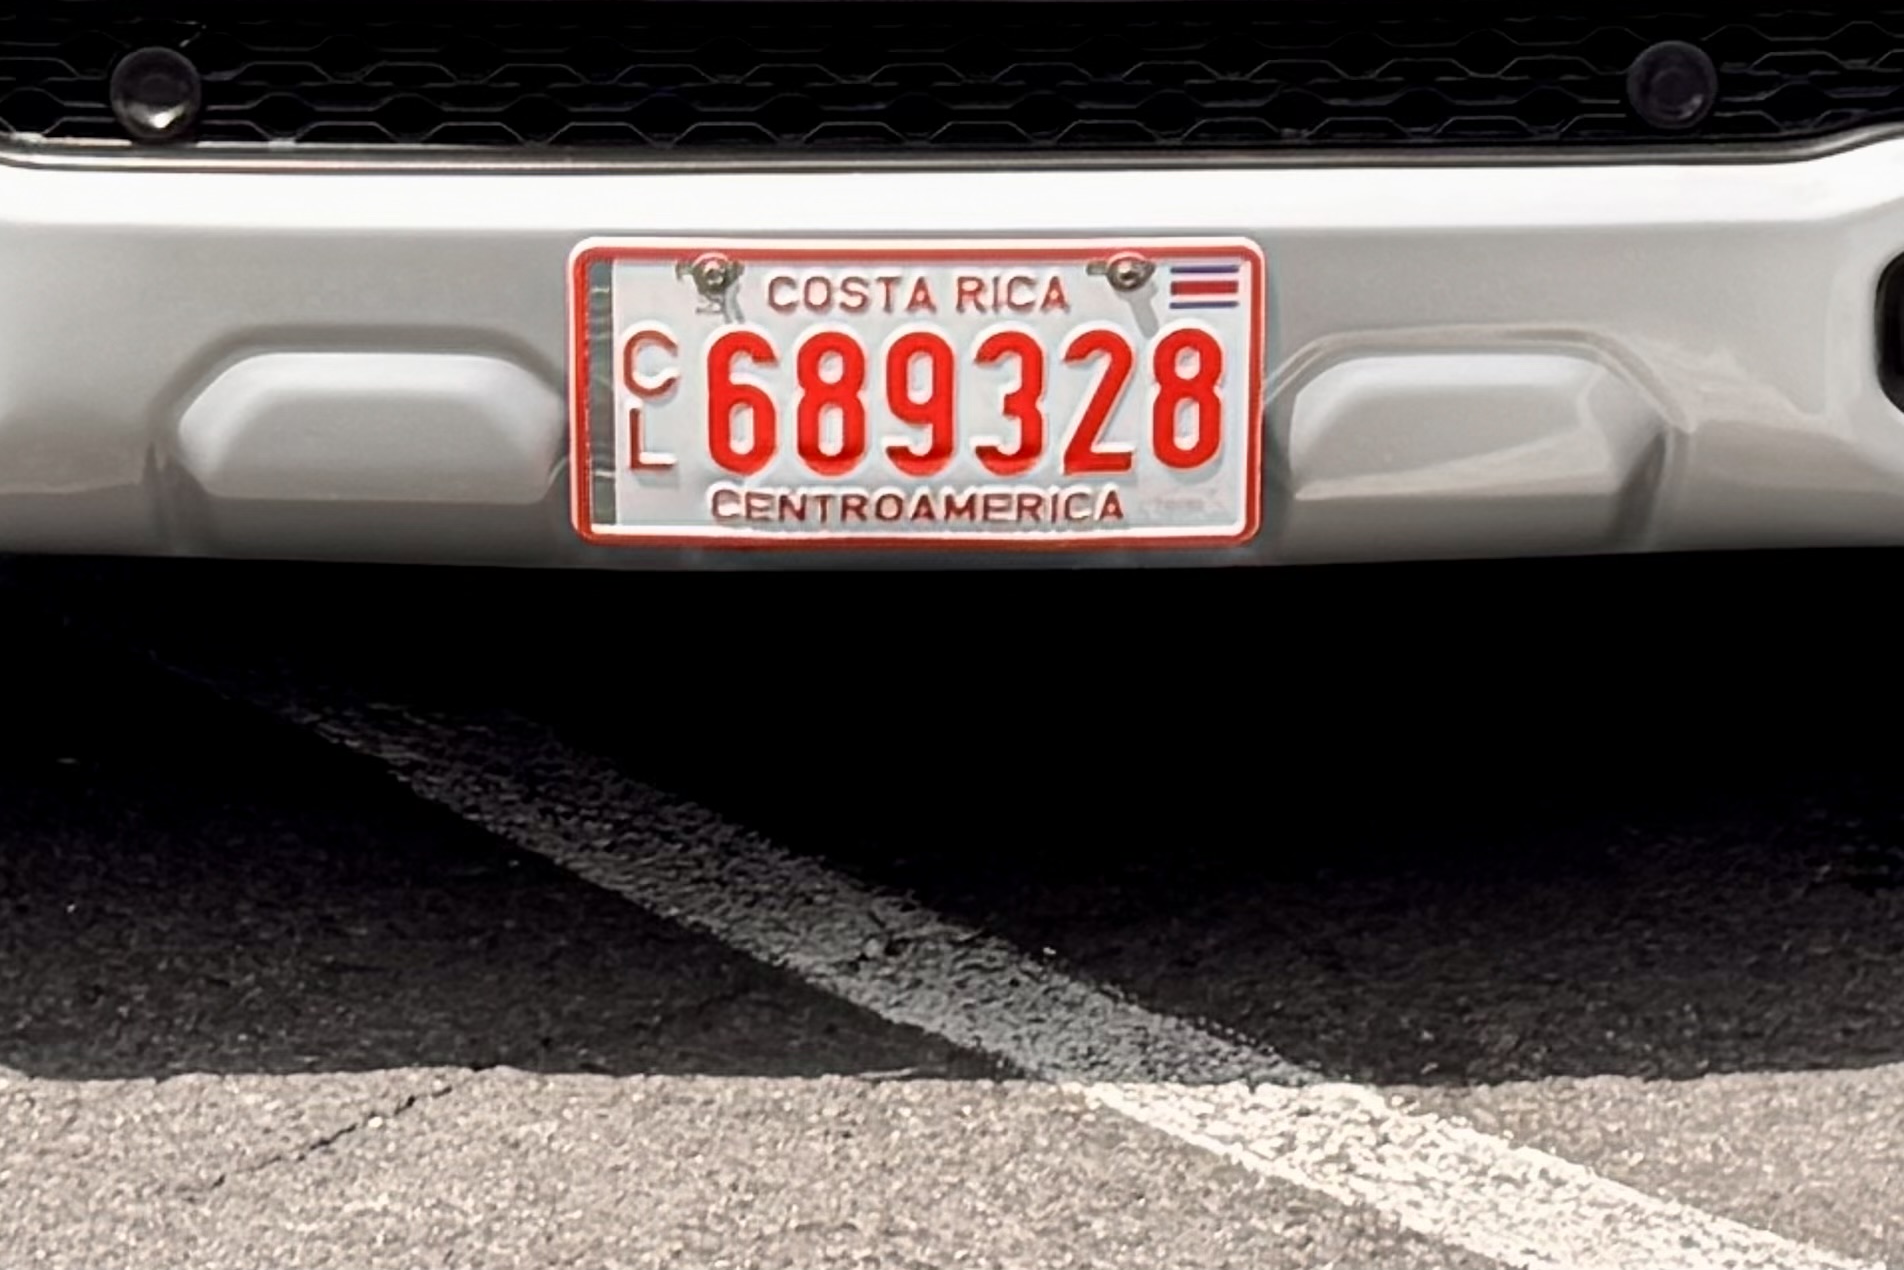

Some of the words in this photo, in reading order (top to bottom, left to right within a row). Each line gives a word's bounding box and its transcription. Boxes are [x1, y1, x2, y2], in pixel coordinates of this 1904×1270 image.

[767, 273, 936, 314] COSTA
[955, 273, 1070, 313] RICA
[706, 328, 1223, 477] 689328
[710, 484, 1126, 523] CENTROAMERICA
